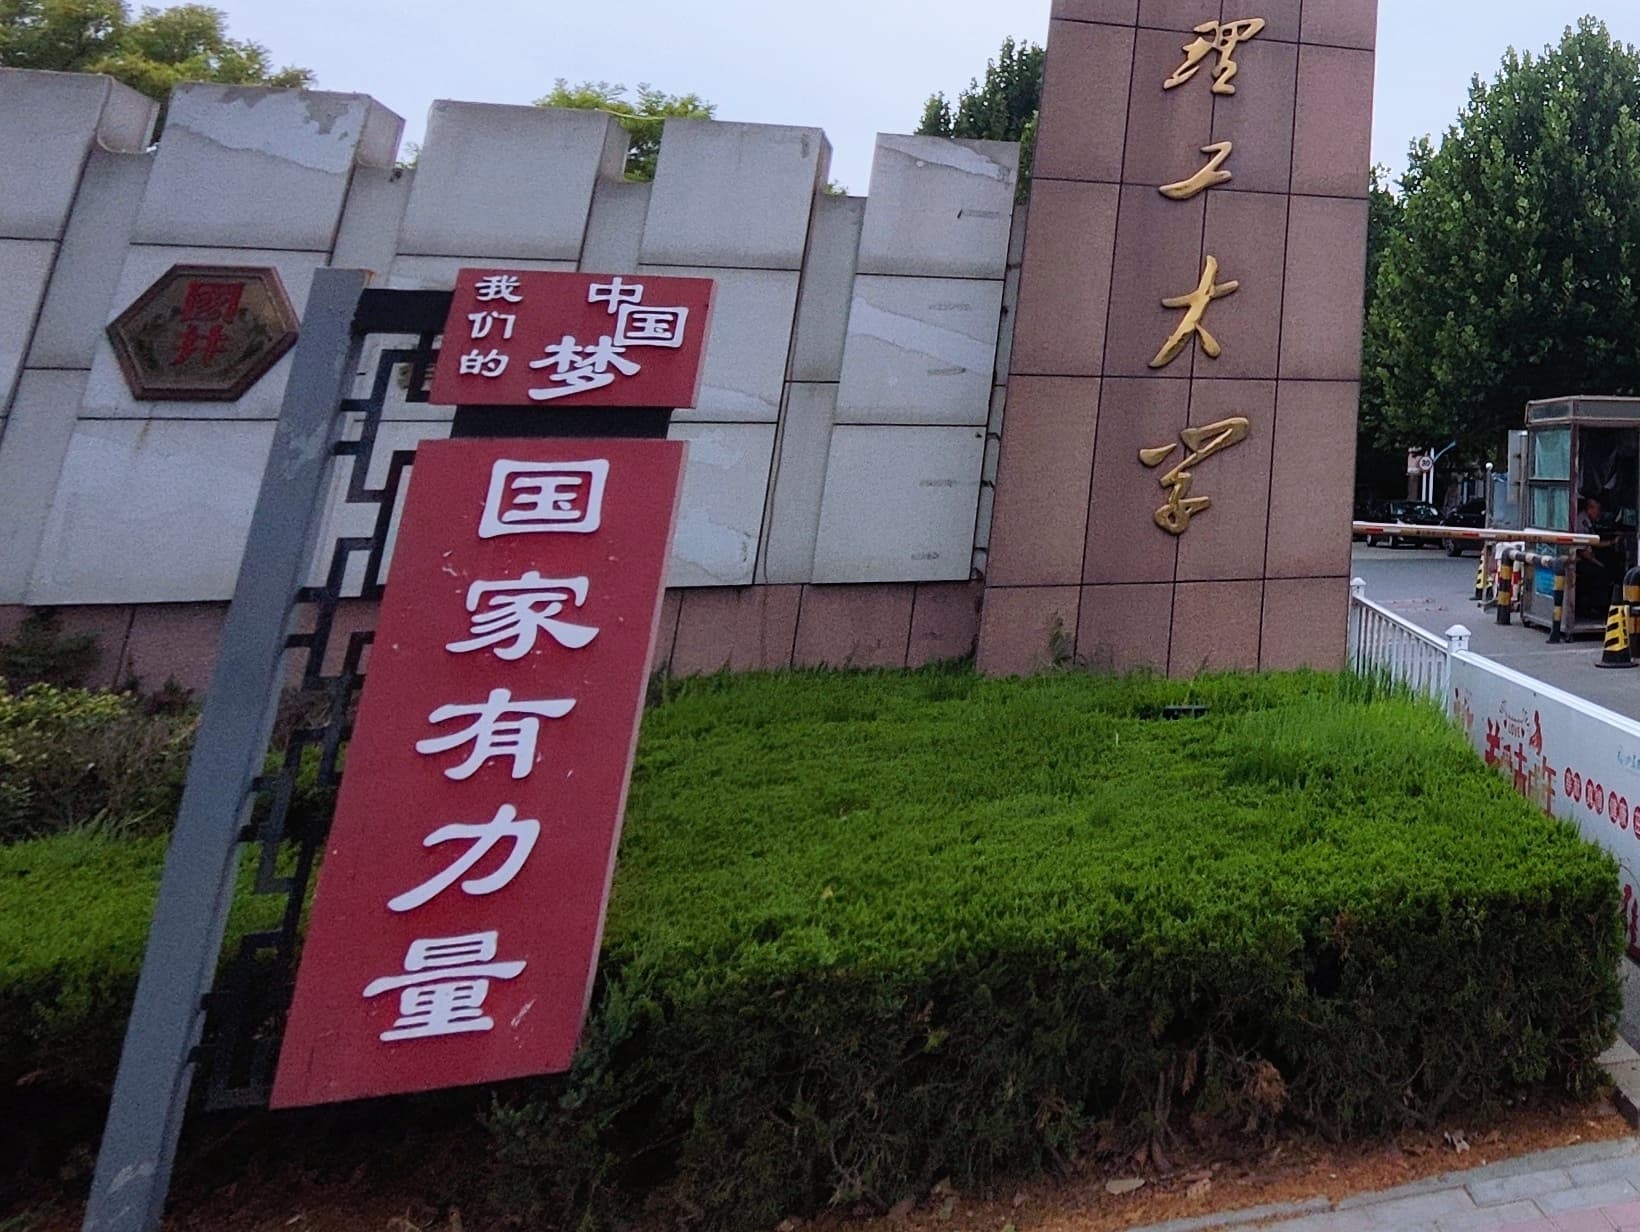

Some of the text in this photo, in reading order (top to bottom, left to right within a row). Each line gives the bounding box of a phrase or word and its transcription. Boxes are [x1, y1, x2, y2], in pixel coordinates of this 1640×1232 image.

[459, 274, 524, 377] 我们的
[362, 458, 610, 1042] 国家有力量
